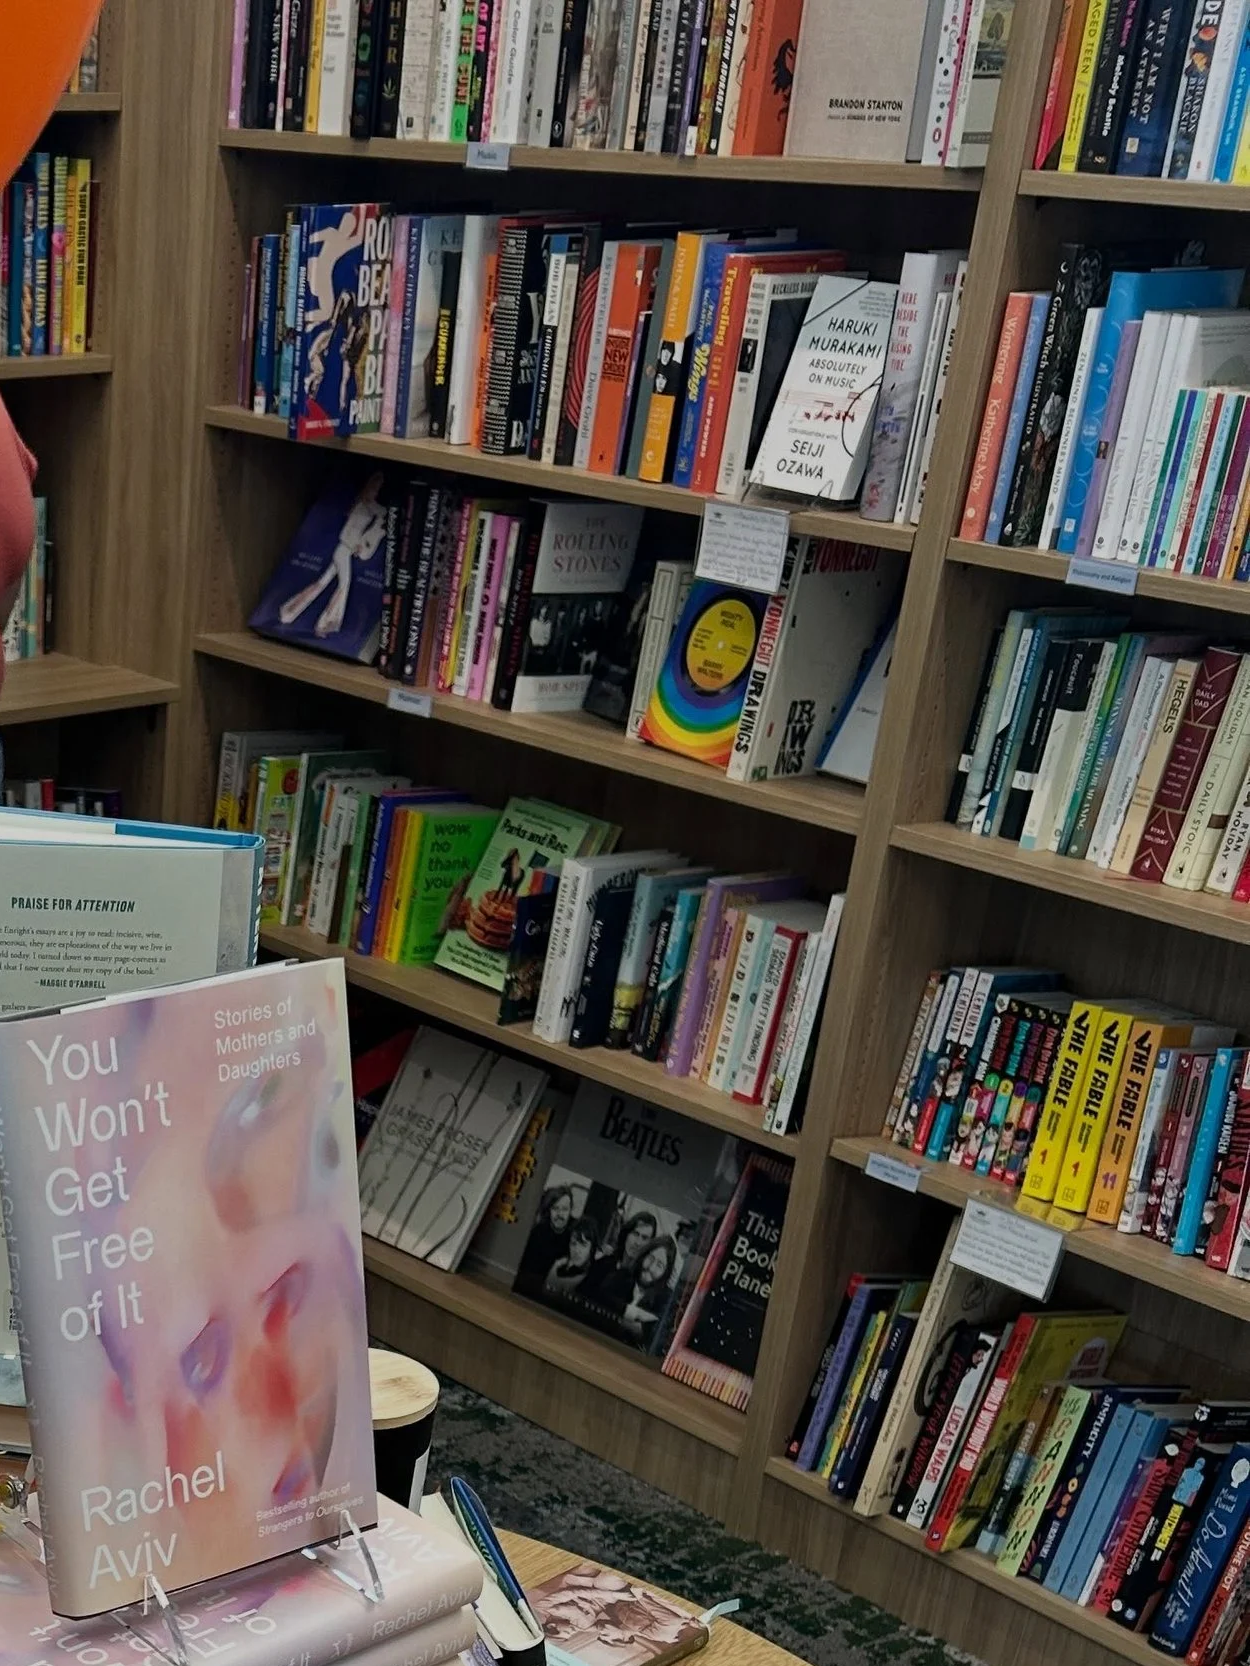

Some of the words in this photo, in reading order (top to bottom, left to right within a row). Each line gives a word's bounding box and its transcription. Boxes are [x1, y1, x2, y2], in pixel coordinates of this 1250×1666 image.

[1108, 54, 1126, 97] Melody
[829, 98, 865, 109] BRANDON
[867, 99, 904, 111] STANTON
[1101, 97, 1117, 137] Beattie
[1179, 76, 1196, 135] BLACKIE
[1187, 76, 1207, 133] SHARON
[827, 316, 879, 337] HARUKI
[604, 348, 629, 363] NEW
[809, 336, 882, 359] MURAKAMI
[992, 316, 1019, 385] Wintering
[808, 359, 868, 376] ABSOLUTELY
[808, 372, 825, 384] ON
[825, 375, 856, 389] MUSIC
[977, 398, 1001, 460] Katherine
[791, 439, 826, 459] SEIJI
[776, 458, 824, 480] OZAWA
[971, 460, 989, 494] May
[553, 533, 629, 551] ROLLING
[553, 555, 623, 573] STONES
[755, 594, 786, 667] VONNEGUT
[1193, 698, 1210, 710] DAD
[1195, 687, 1217, 702] DAILY
[735, 669, 768, 756] DRAWINGS
[1197, 779, 1217, 819] DAILY
[431, 841, 451, 853] no
[1181, 818, 1204, 857] STOIC
[1221, 810, 1243, 861] HOLIDAY
[428, 858, 470, 872] thank
[11, 896, 50, 911] PRAISE
[52, 899, 73, 911] FOR
[75, 899, 136, 913] ATTENTION
[214, 1003, 272, 1030] Stories
[276, 996, 294, 1018] of
[216, 1028, 283, 1057] Mothers
[288, 1019, 317, 1040] and
[1067, 1023, 1090, 1056] THE
[1097, 1032, 1120, 1067] THE
[27, 1035, 119, 1086] You
[218, 1050, 302, 1082] Daughters
[1129, 1043, 1152, 1077] THE
[1052, 1056, 1079, 1109] FABLE
[1082, 1068, 1110, 1120] FABLE
[34, 1081, 172, 1152] Won't
[1116, 1078, 1142, 1131] FABLE
[599, 1096, 685, 1167] BEATLES
[1039, 1148, 1048, 1165] 1
[1071, 1161, 1080, 1178] 1
[45, 1157, 130, 1217] Get
[1102, 1172, 1117, 1190] 11
[745, 1210, 780, 1243] This
[51, 1226, 154, 1282] Free
[59, 1289, 103, 1342] of
[117, 1281, 144, 1330] It
[81, 1450, 226, 1533] Rachel
[89, 1531, 178, 1590] Aviv
